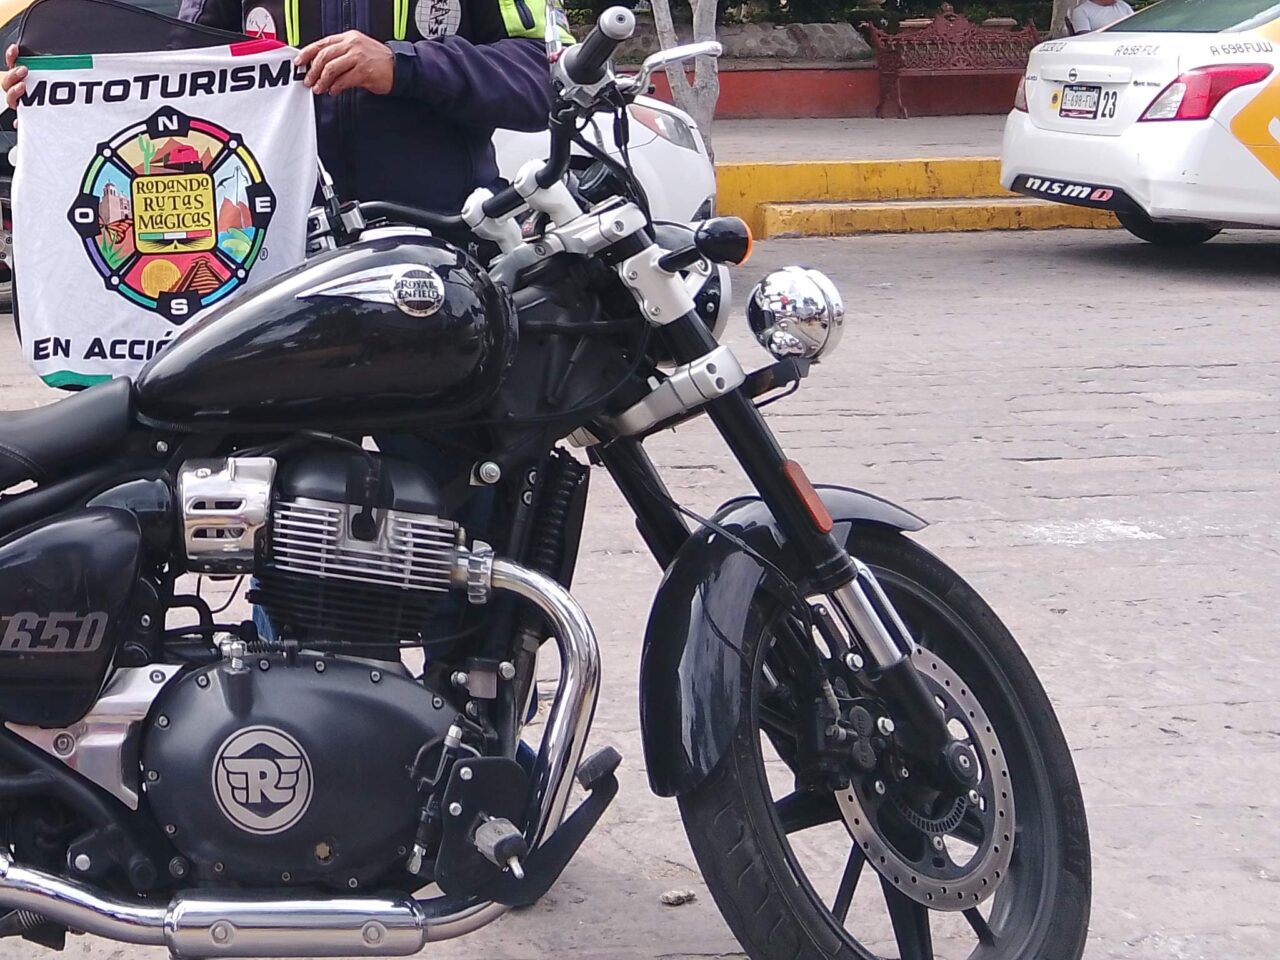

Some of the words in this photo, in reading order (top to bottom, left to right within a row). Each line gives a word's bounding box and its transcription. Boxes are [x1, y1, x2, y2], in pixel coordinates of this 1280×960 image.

[1101, 91, 1117, 118] 23
[157, 115, 179, 131] N
[1025, 176, 1114, 202] nismo
[255, 196, 271, 212] E
[74, 207, 94, 223] O
[400, 279, 436, 290] ROYAL
[397, 289, 440, 300] ENFIELD
[170, 298, 189, 315] S
[33, 337, 71, 361] EN
[0, 611, 109, 652] 650
